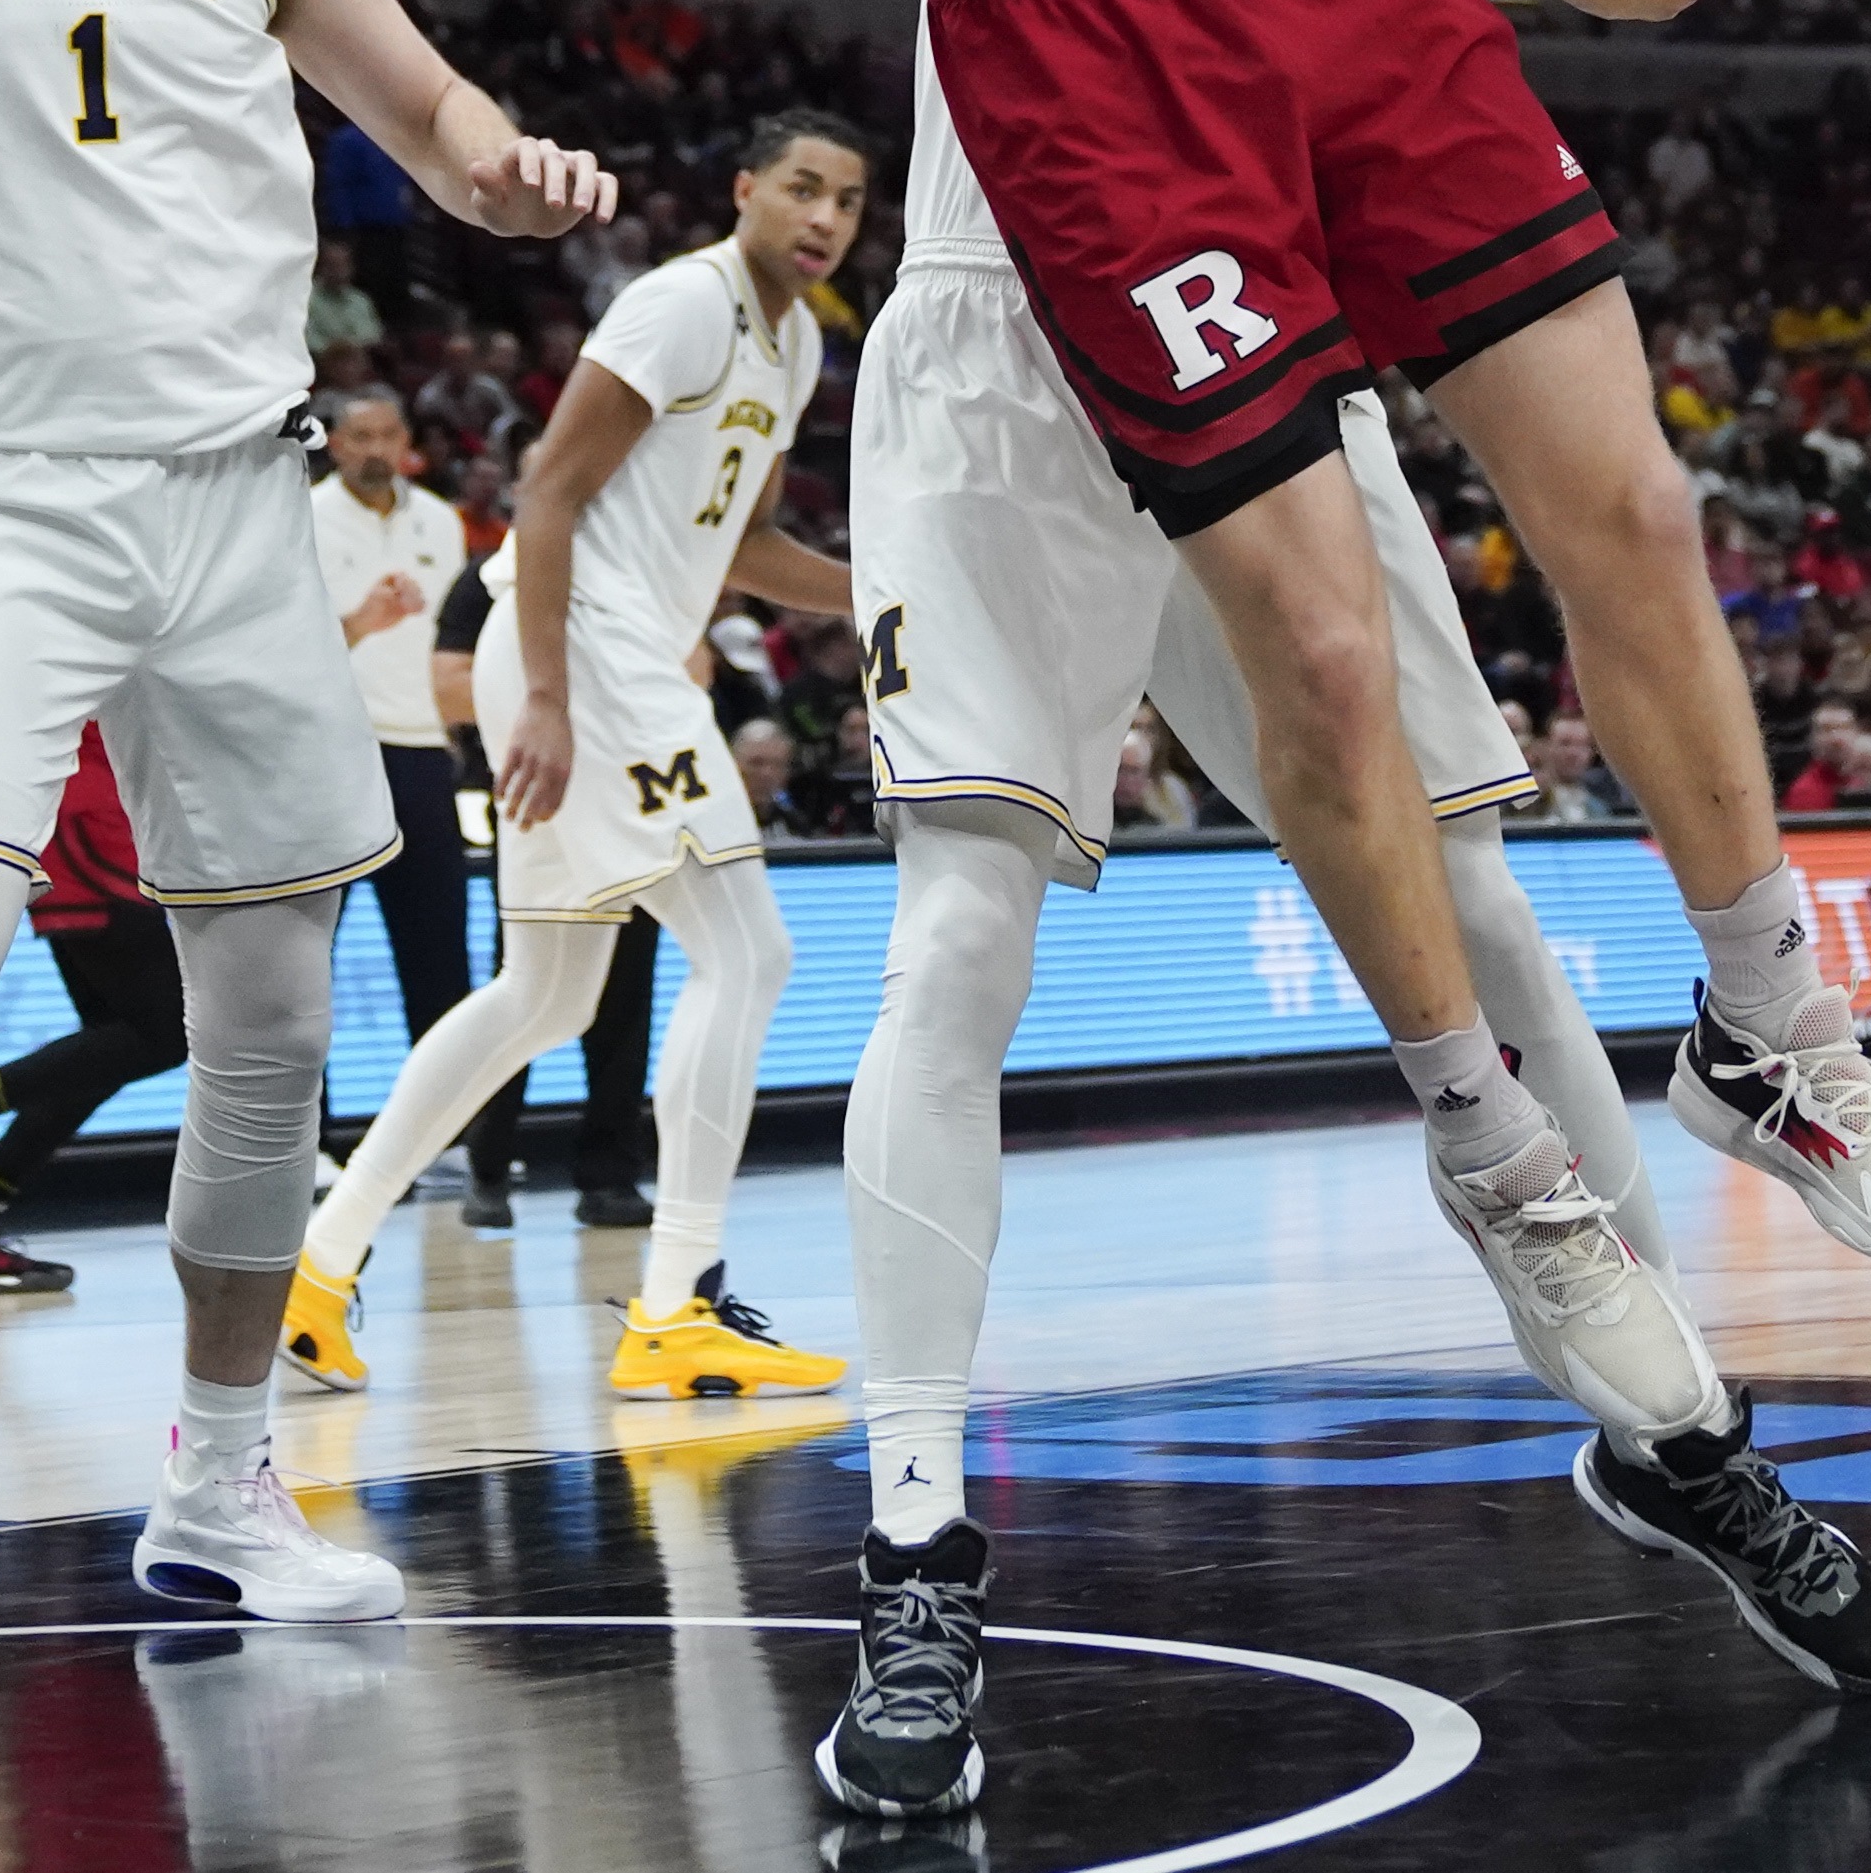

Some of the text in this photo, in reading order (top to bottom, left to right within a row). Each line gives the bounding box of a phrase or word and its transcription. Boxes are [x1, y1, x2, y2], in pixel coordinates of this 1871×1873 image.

[66, 12, 119, 145] 1
[1129, 249, 1280, 394] R
[628, 748, 709, 817] M
